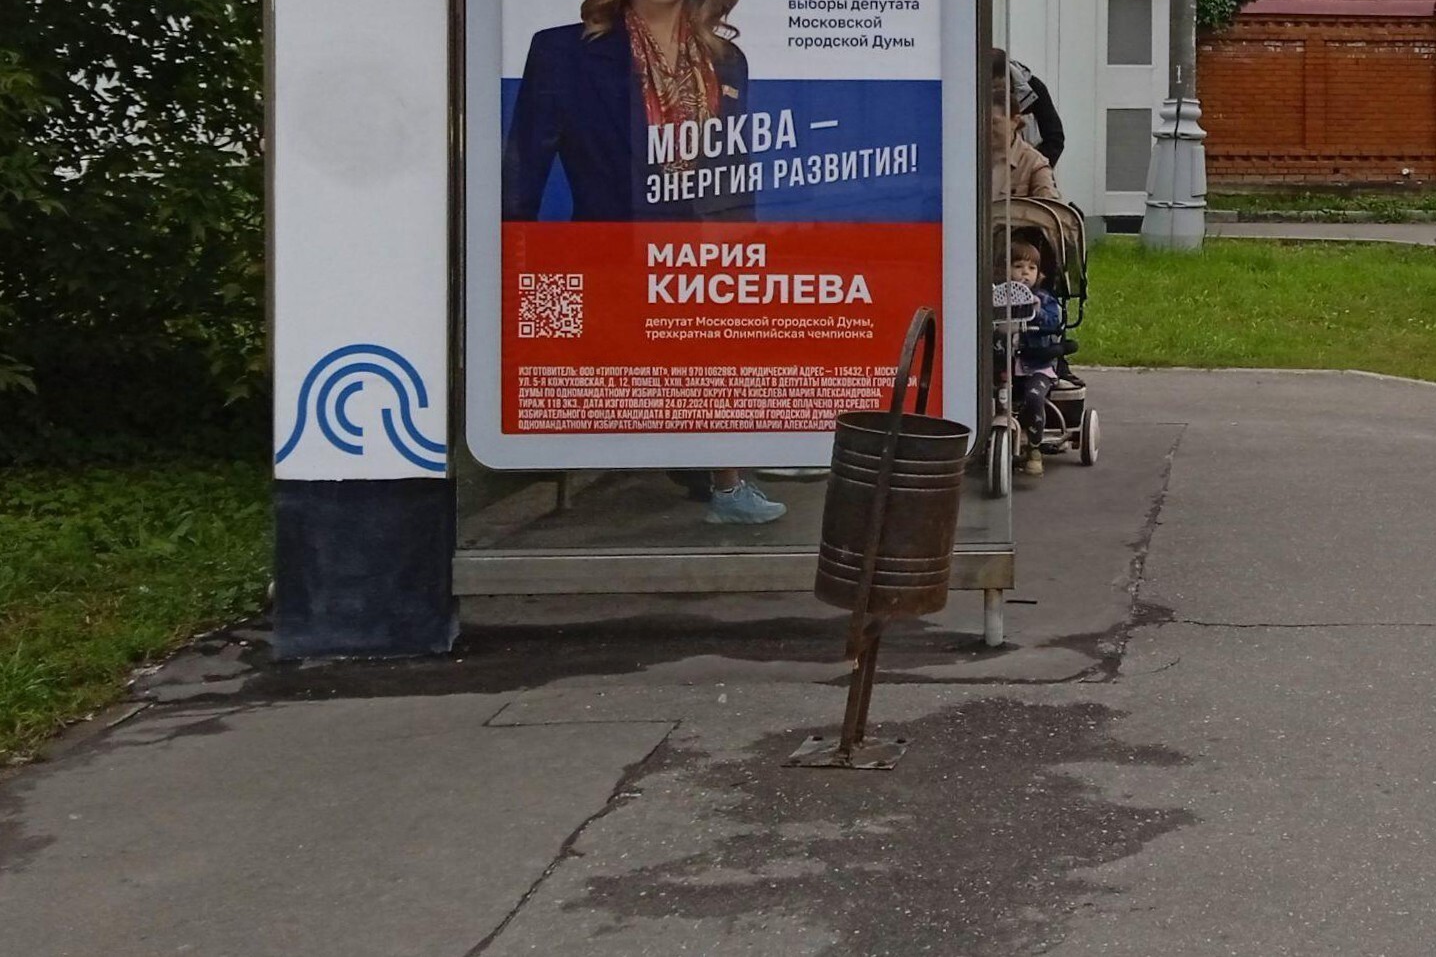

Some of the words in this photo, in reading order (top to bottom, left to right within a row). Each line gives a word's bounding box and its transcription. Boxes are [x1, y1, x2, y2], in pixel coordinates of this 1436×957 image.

[851, 0, 920, 13] депутата
[788, 16, 882, 28] Московской
[788, 35, 868, 49] городской
[872, 35, 914, 50] Думы
[647, 109, 797, 164] МОСКВА
[646, 161, 763, 204] ЭНЕРГИЯ
[774, 143, 918, 189] РАЗВИТИЯ!
[647, 243, 766, 267] МАРИЯ
[647, 274, 873, 305] КИСЕЛЕВА
[645, 318, 693, 329] депутат
[696, 316, 769, 327] Московской
[771, 316, 833, 329] городской
[837, 317, 874, 329] Думы,
[645, 329, 721, 340] трехкратная
[723, 328, 804, 339] Олимпийская
[807, 330, 873, 339] чемпионка
